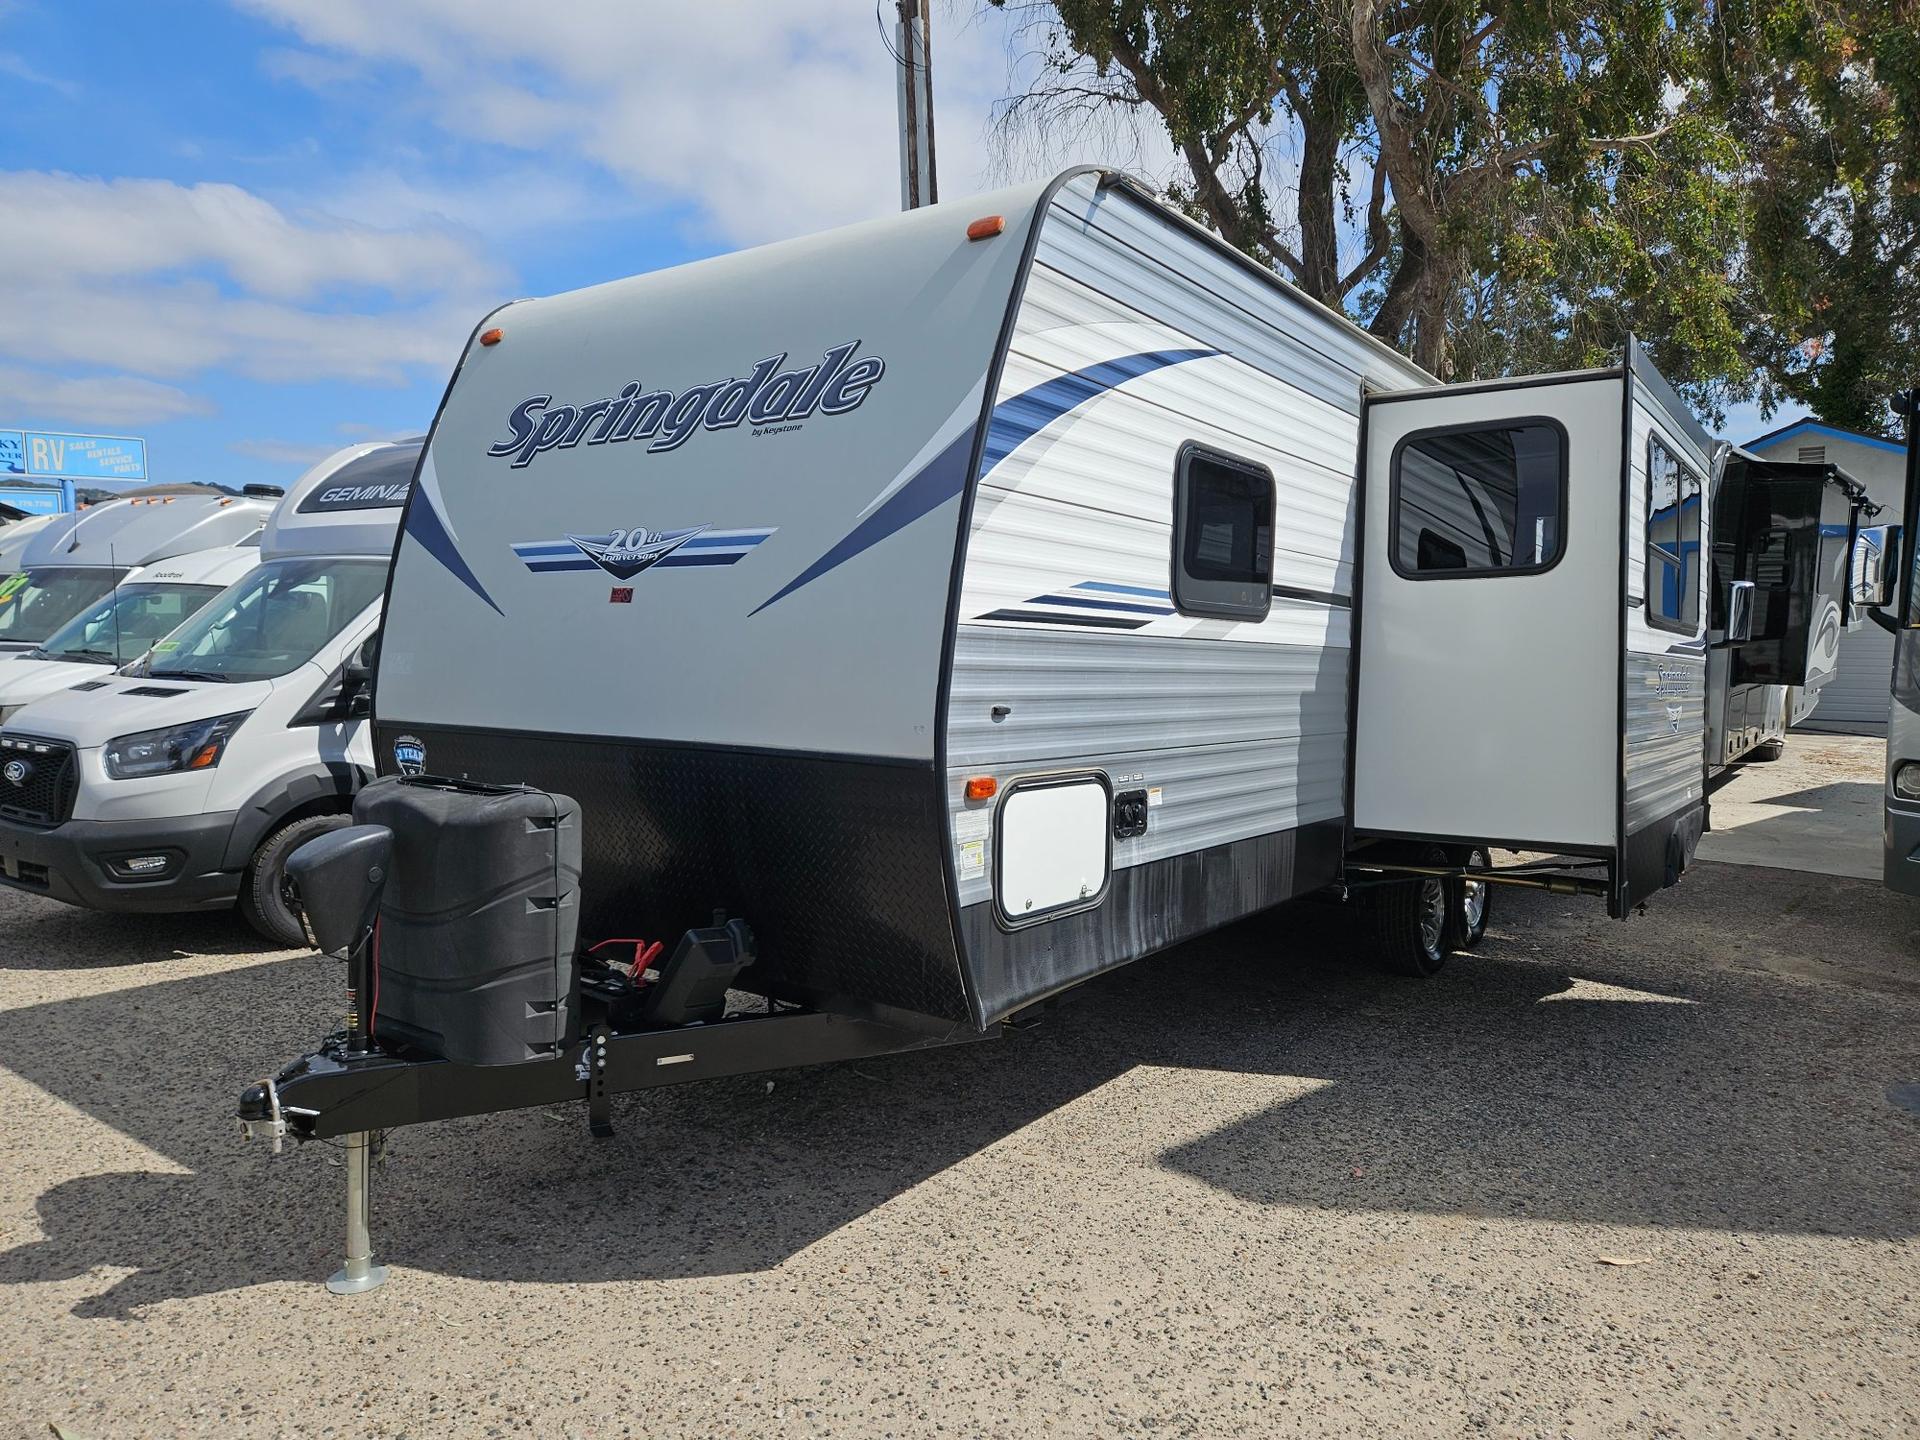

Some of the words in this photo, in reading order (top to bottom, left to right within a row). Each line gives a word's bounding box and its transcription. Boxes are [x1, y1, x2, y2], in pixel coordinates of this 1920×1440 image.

[487, 339, 885, 468] Springdale
[752, 428, 763, 437] by
[763, 424, 803, 435] Keystone
[69, 441, 97, 451] SALES
[87, 446, 122, 459] RENTALS
[32, 438, 65, 470] RV
[99, 455, 133, 466] SERVICE
[113, 463, 141, 473] PARTS
[319, 484, 399, 502] GEMINI
[603, 526, 662, 552] 20th
[598, 551, 660, 562] Anniversary
